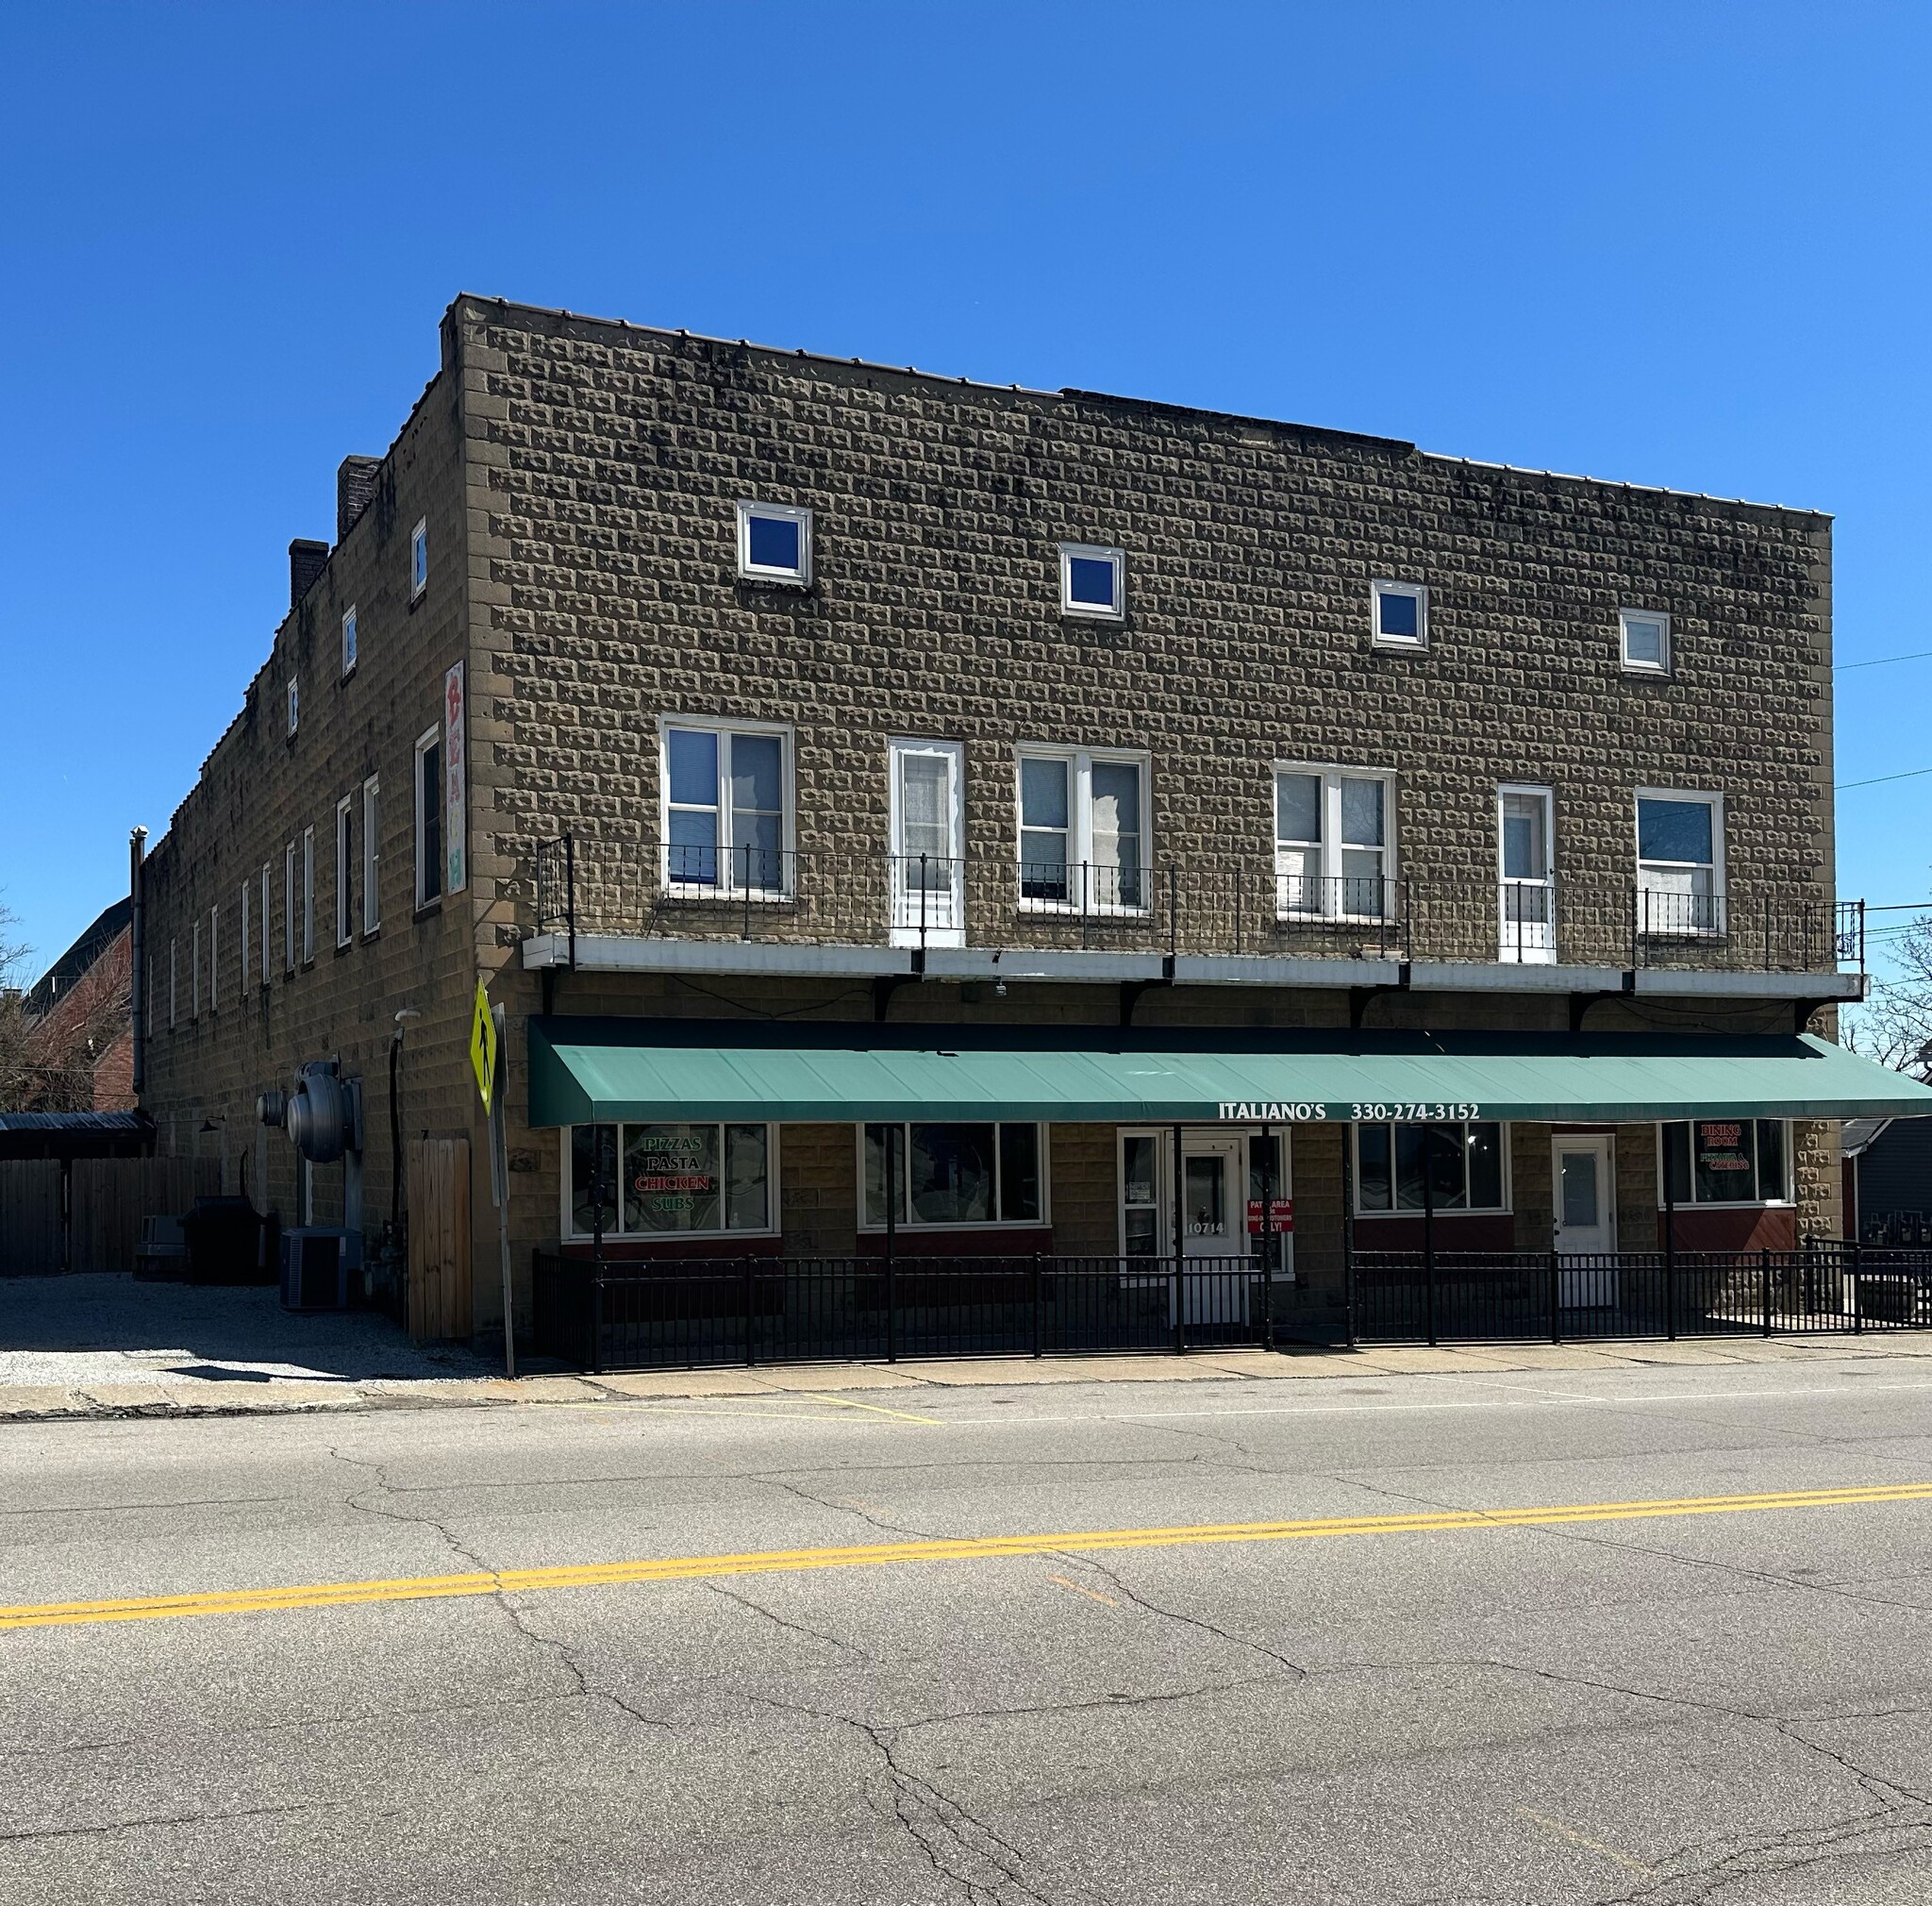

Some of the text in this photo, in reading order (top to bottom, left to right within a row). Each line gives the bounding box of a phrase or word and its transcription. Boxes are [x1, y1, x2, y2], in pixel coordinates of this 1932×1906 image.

[1218, 1102, 1480, 1120] ITALIANO'S 330-274-3152
[1701, 1124, 1741, 1136] DINING
[643, 1137, 701, 1151] PIZZAS
[1707, 1136, 1738, 1146] ROOM
[646, 1156, 700, 1170] PASTA
[635, 1176, 709, 1191] CHICKEN
[652, 1195, 695, 1211] SUBS
[1250, 1200, 1290, 1209] PAT AREA
[1188, 1222, 1224, 1233] 10714
[1259, 1221, 1282, 1232] OLY!
